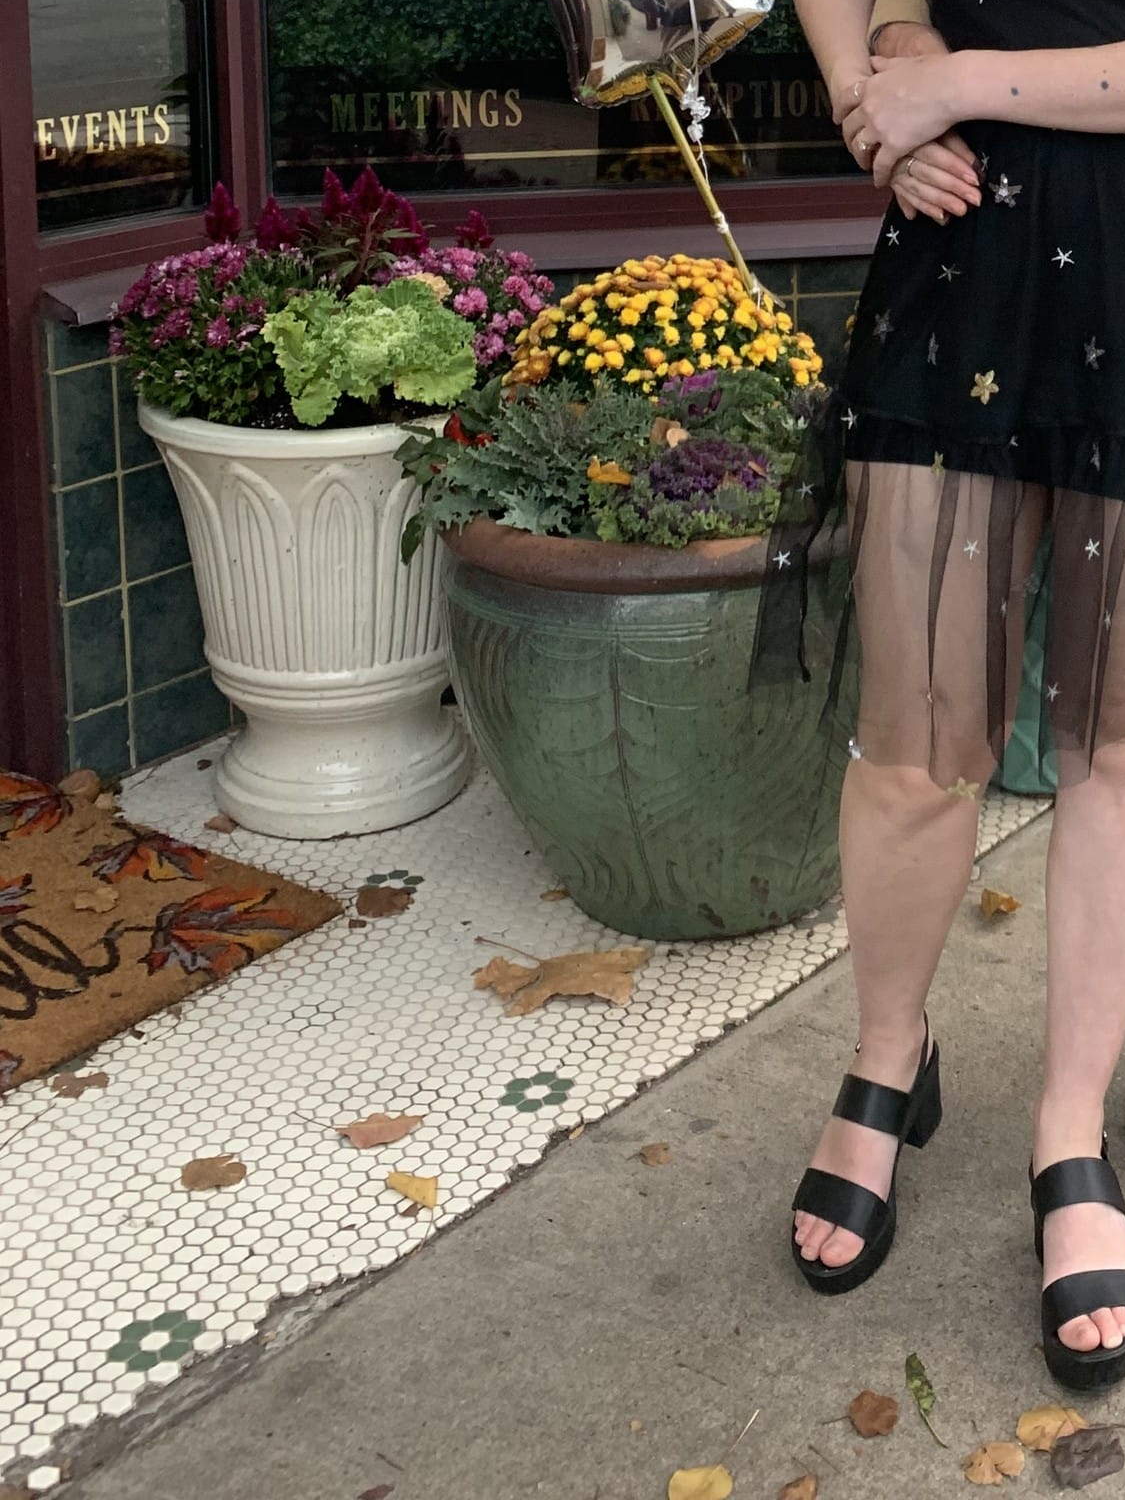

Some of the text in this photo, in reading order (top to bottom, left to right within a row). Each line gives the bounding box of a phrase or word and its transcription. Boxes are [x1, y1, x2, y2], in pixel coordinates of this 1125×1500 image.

[330, 88, 523, 133] MEETINGS
[628, 79, 834, 123] REPTION
[36, 104, 171, 160] EVENTS
